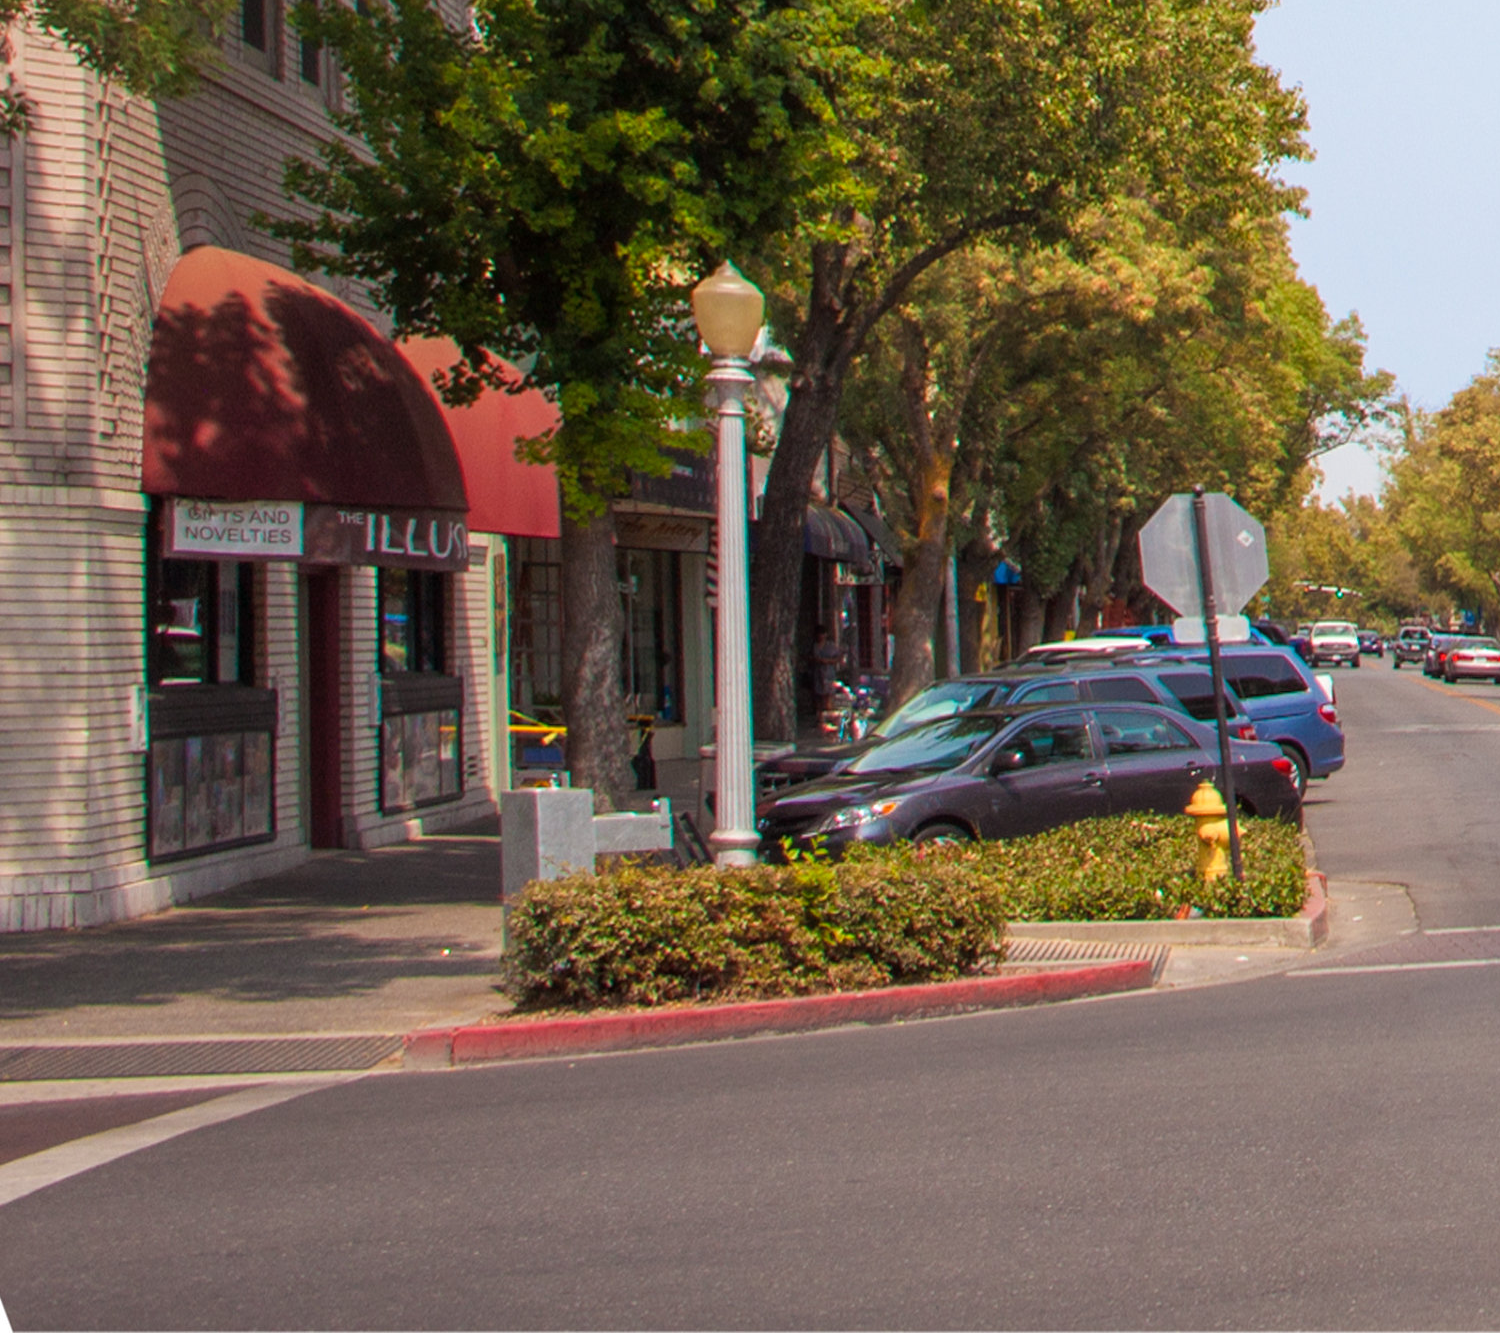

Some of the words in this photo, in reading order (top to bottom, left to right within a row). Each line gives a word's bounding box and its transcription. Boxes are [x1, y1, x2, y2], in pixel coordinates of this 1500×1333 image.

[187, 506, 245, 525] GIFTS
[249, 509, 291, 525] AND
[337, 510, 365, 526] THE
[184, 525, 293, 544] NOVELTIES
